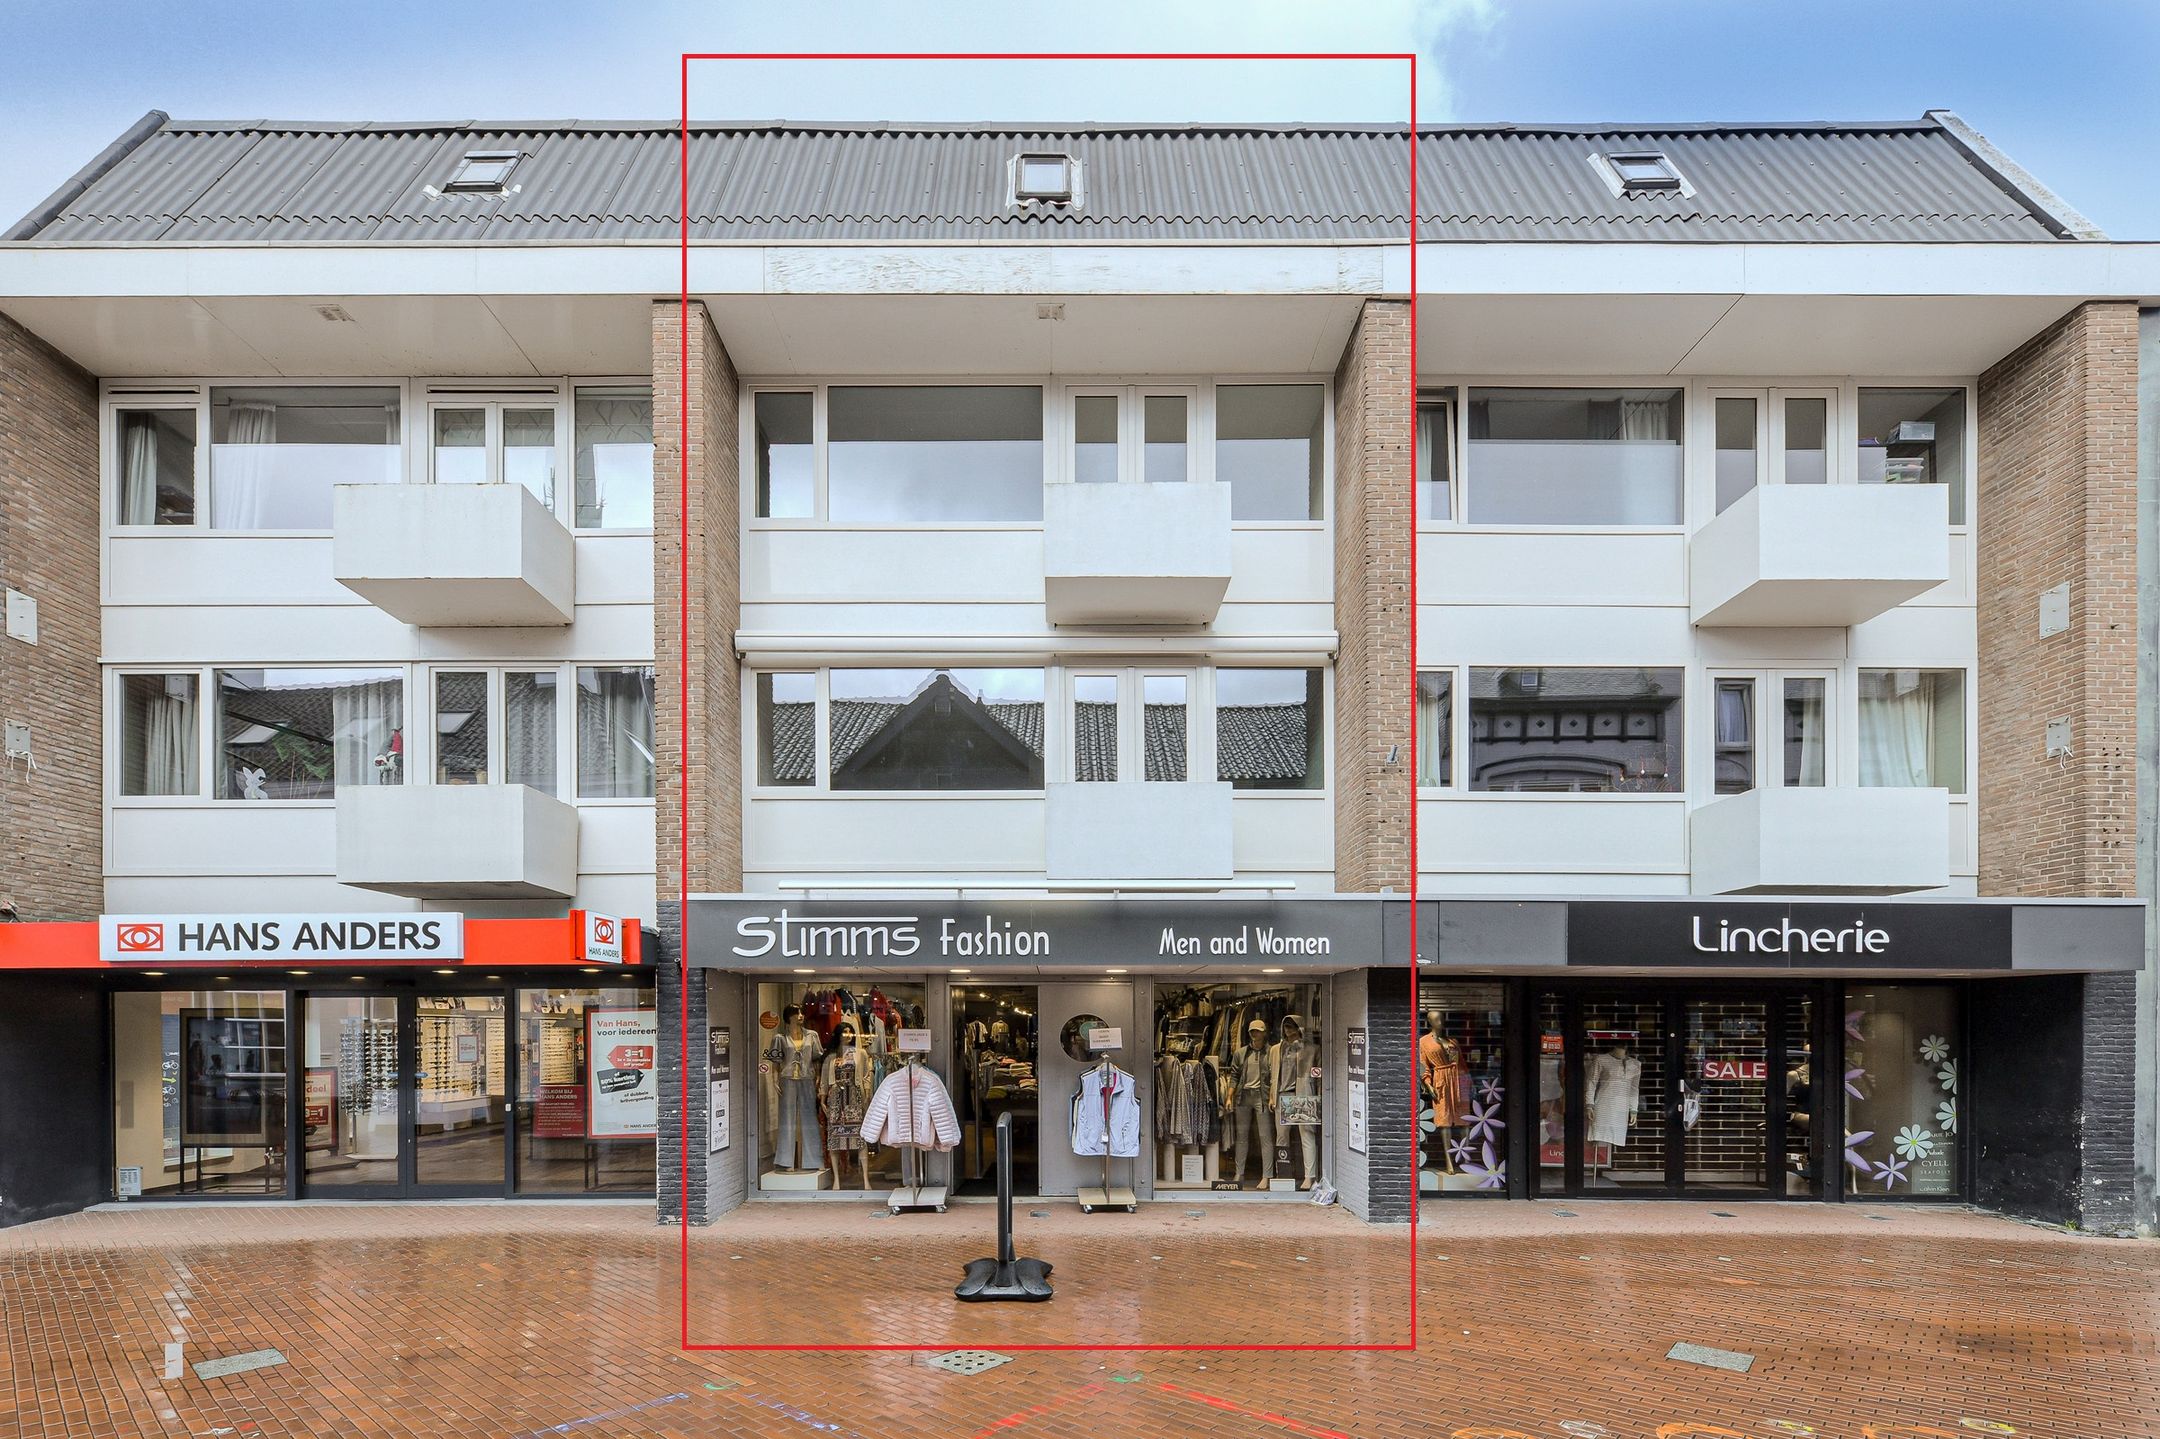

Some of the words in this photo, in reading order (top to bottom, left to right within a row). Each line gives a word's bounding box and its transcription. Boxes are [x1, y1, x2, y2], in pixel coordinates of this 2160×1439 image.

[178, 922, 280, 951] HANS
[292, 920, 441, 951] ANDERS
[732, 908, 920, 957] Stimms
[940, 915, 1050, 956] Fashion
[1158, 927, 1201, 955] Men
[1209, 925, 1248, 955] and
[1255, 927, 1330, 955] Women
[1693, 916, 1890, 953] Lincherie
[588, 946, 601, 956] HANS
[602, 948, 620, 959] ANDERS
[597, 1020, 614, 1028] Van
[616, 1019, 641, 1027] Hans,
[618, 1028, 657, 1036] iedereen
[624, 1048, 644, 1058] 3=1
[1705, 1061, 1766, 1079] SALE
